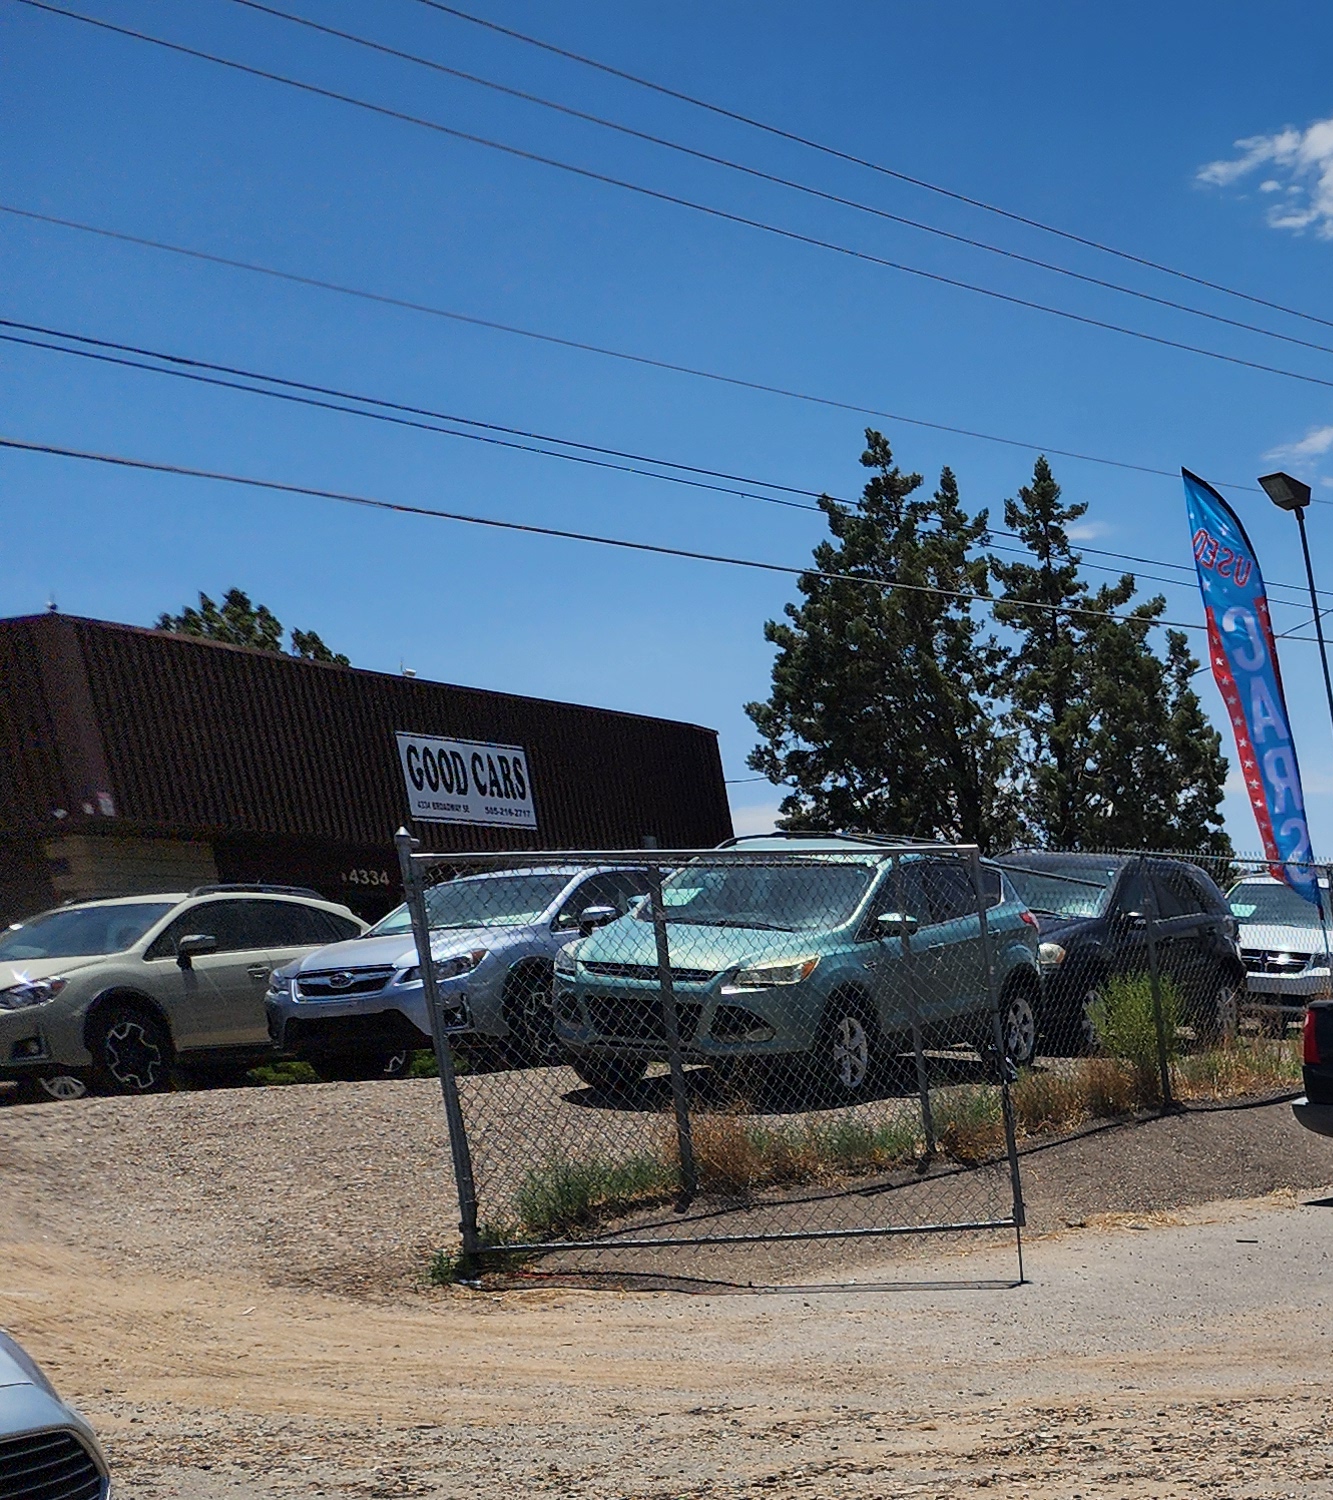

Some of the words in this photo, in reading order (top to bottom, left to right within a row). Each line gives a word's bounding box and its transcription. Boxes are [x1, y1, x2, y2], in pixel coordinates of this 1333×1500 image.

[406, 744, 468, 796] GOOD
[470, 752, 526, 800] CARS
[349, 868, 390, 886] 4334
